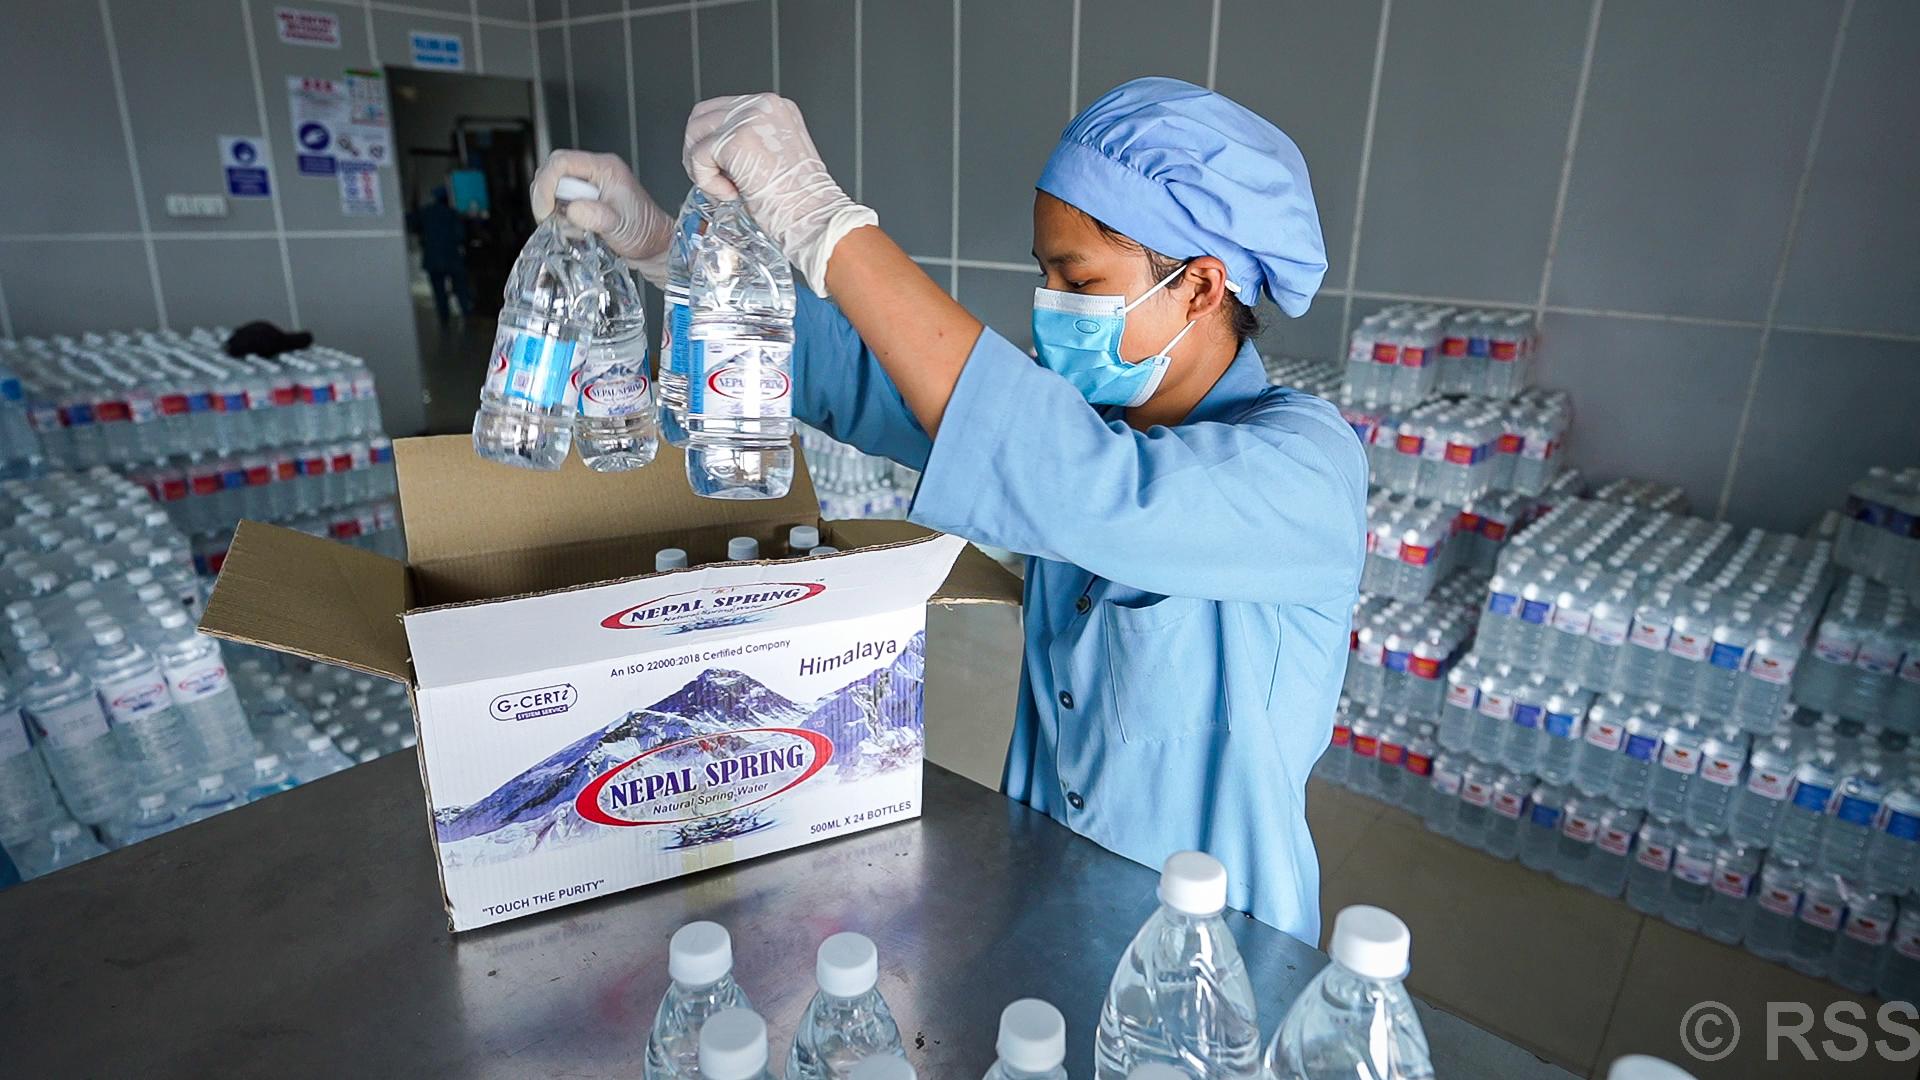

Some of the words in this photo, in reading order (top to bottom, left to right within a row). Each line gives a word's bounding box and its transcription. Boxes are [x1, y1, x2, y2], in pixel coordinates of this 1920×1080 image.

[630, 600, 704, 622] NEPAL
[712, 589, 800, 608] SPRING
[663, 612, 699, 622] Natural
[701, 608, 734, 616] Spring
[610, 668, 624, 677] An
[627, 664, 644, 675] ISO
[647, 653, 700, 671] 22000:2018
[702, 646, 743, 661] Certified
[745, 640, 791, 653] Company
[799, 639, 897, 676] Himalaya
[610, 768, 696, 810] NEPAL
[705, 744, 804, 787] SPRING
[653, 798, 694, 815] Natural
[698, 790, 734, 805] Spring
[737, 783, 768, 796] Water
[810, 819, 841, 834] 500ML
[844, 816, 851, 826] X
[853, 813, 864, 823] 24
[867, 800, 912, 820] BOTTLES
[482, 898, 530, 916] "TOUCH
[533, 891, 555, 905] THE
[558, 879, 605, 899] PURITY"
